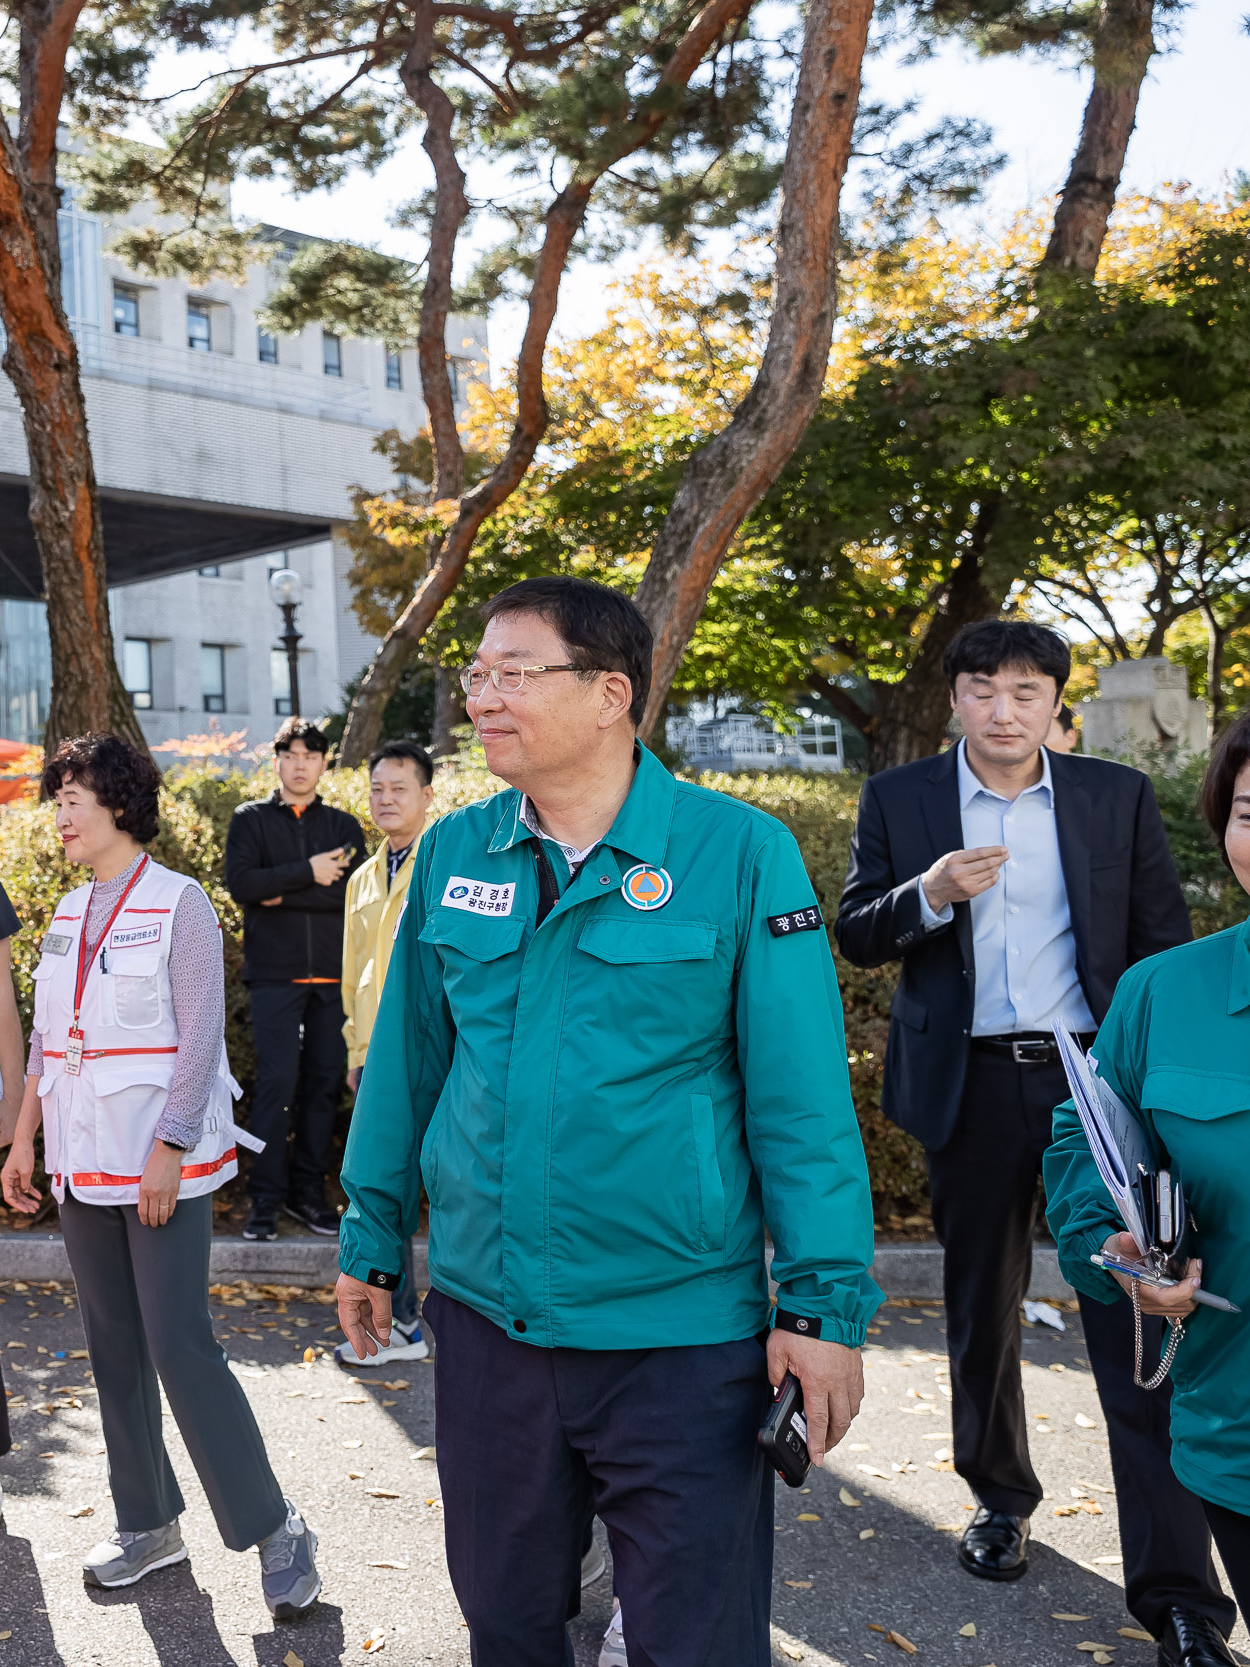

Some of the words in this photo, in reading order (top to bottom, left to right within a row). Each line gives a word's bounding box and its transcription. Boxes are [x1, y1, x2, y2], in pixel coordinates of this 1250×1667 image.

[467, 897, 508, 912] 광진구청장
[775, 909, 817, 932] 광진구
[113, 928, 158, 943] 현장응급의료소장
